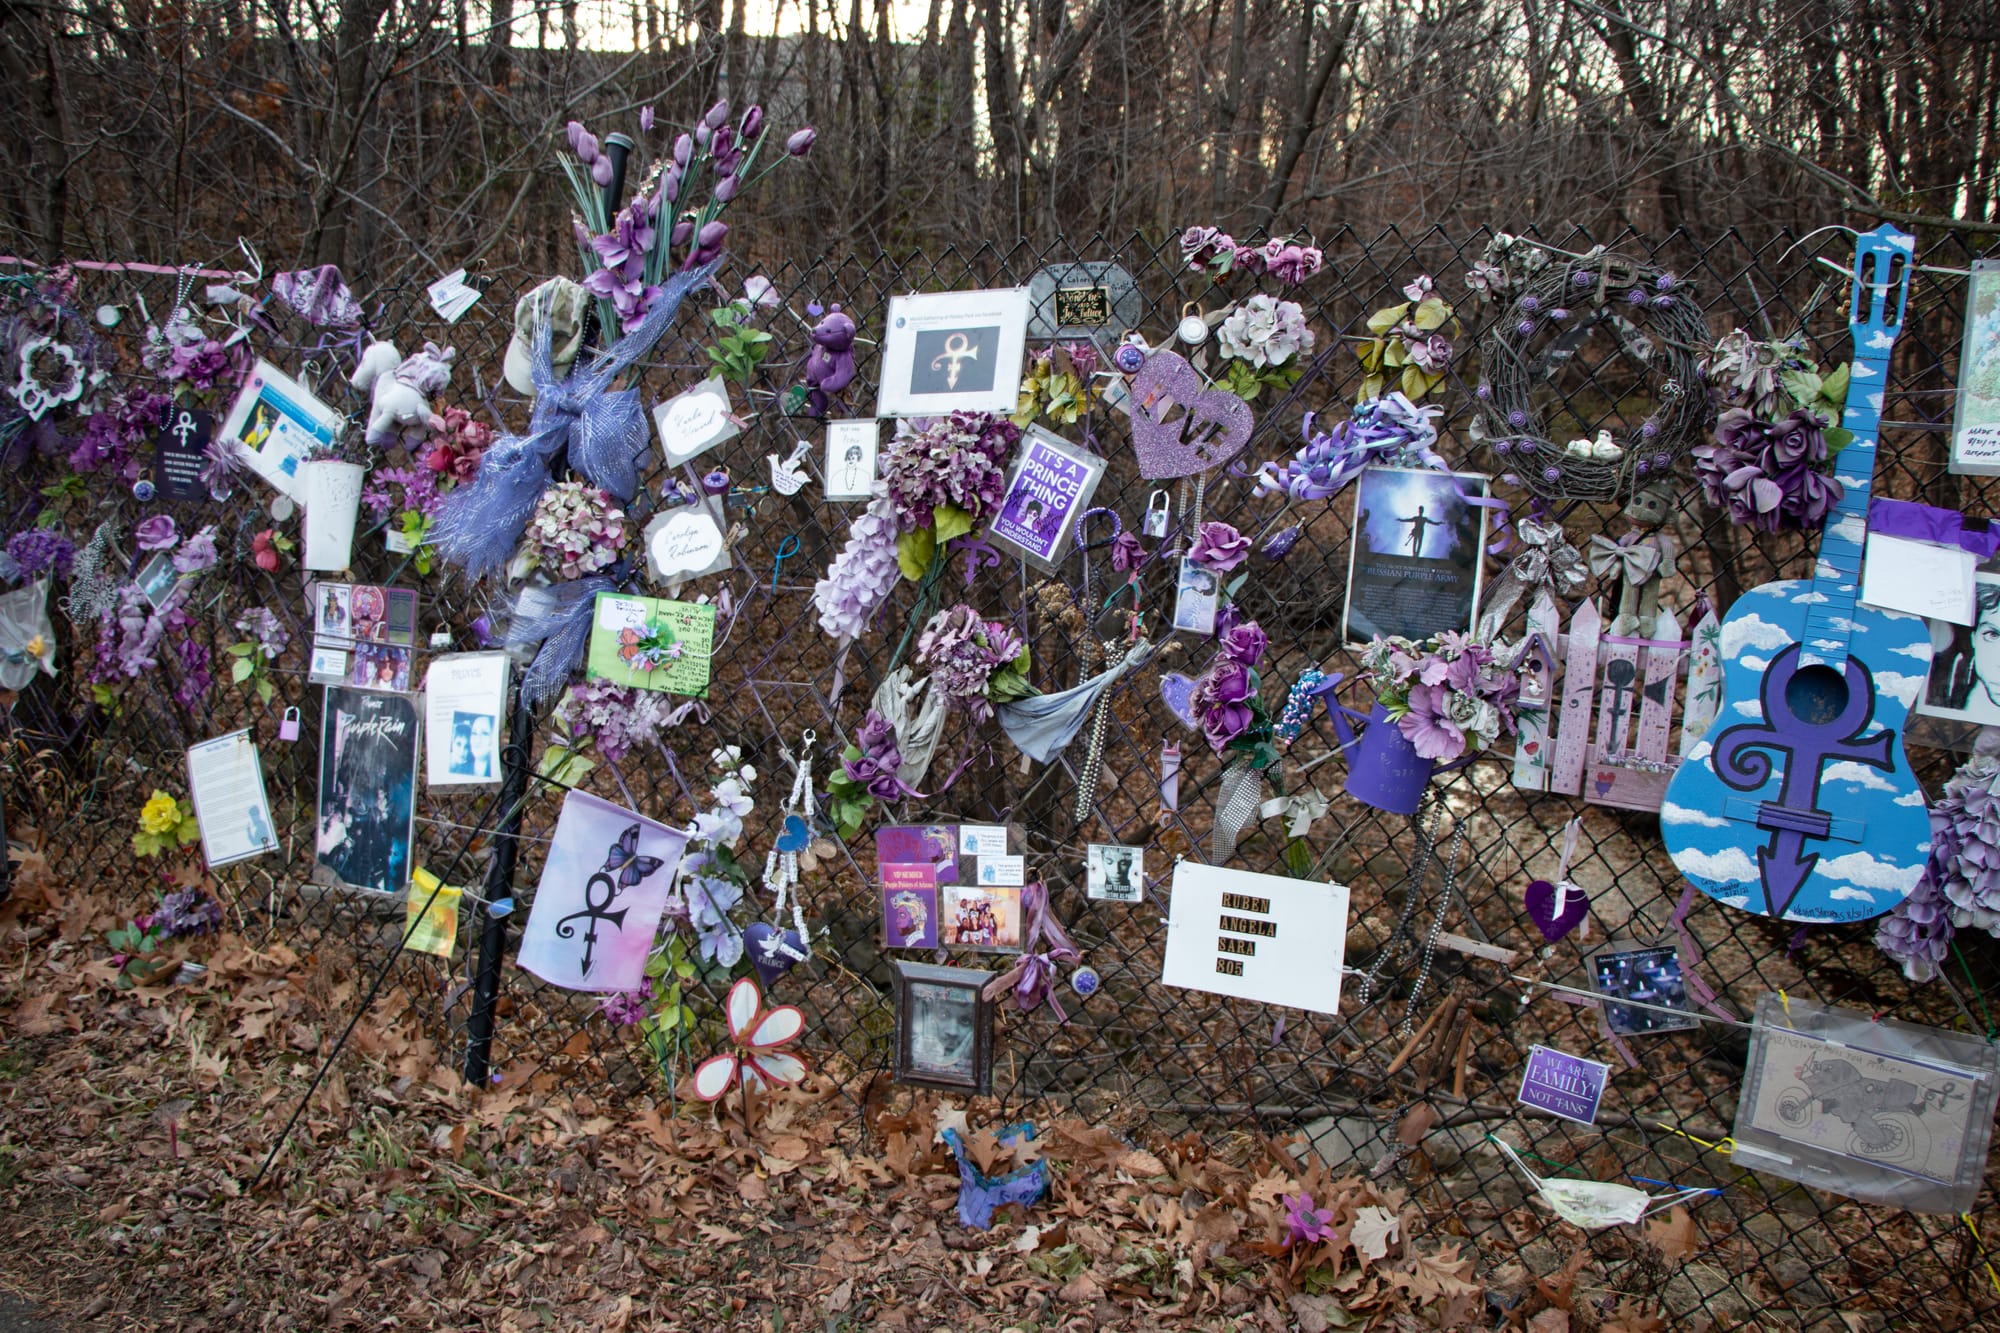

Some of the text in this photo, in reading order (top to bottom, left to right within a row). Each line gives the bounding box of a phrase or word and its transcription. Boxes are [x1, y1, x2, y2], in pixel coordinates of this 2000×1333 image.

[1039, 448, 1077, 478] IT'S A
[1023, 458, 1079, 497] PRINCE
[1021, 475, 1068, 510] THING
[1001, 517, 1015, 529] YOU
[1001, 526, 1042, 552] UNDERSTAND
[1367, 567, 1459, 583] RUSSIAN PURPLE ARMY
[340, 713, 406, 752] Purple Rain
[1222, 893, 1269, 913] RUBEN
[1221, 916, 1275, 937] ANGELA
[1219, 938, 1254, 955] SARA
[757, 954, 785, 969] PRINCE
[1217, 959, 1242, 976] 805
[1547, 1056, 1588, 1078] WE ARE
[1531, 1064, 1596, 1099] FAMILY!
[1528, 1087, 1588, 1115] NOT "FANS"
